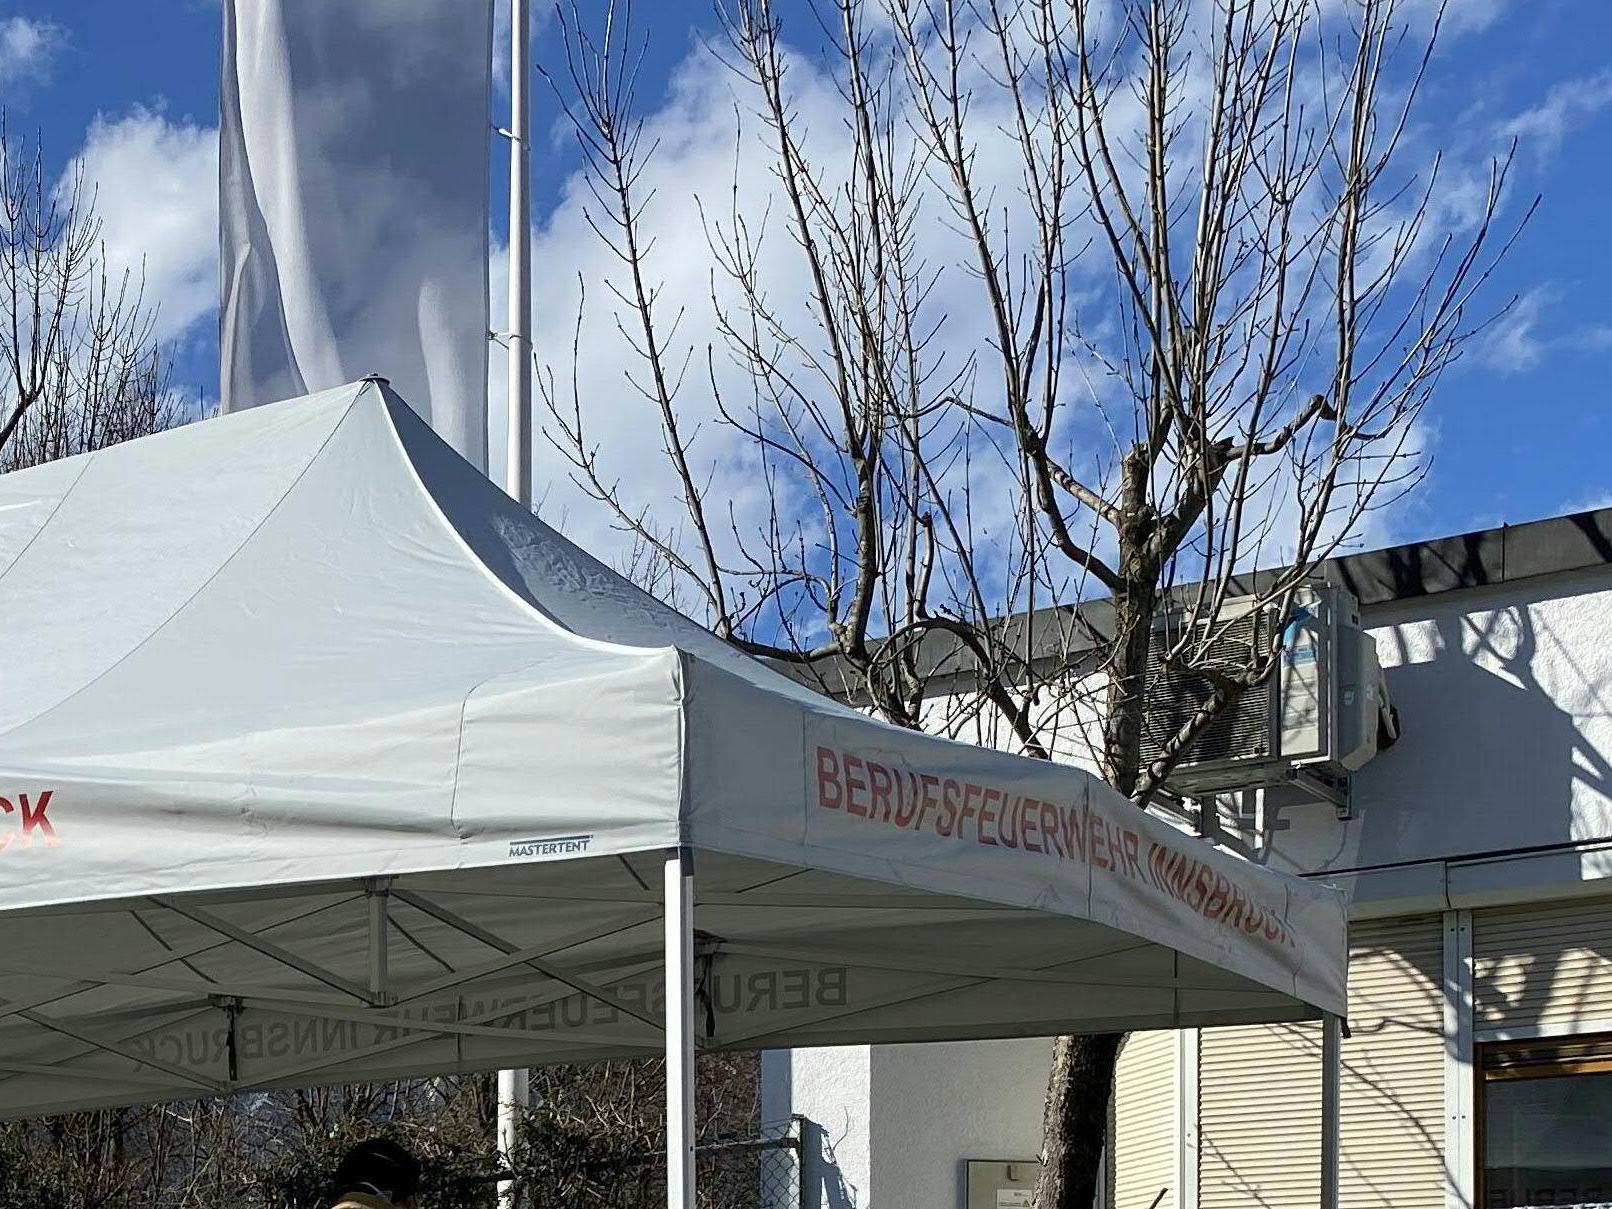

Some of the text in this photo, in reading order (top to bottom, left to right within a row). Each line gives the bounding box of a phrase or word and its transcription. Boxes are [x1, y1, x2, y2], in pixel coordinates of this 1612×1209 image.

[508, 839, 590, 857] MASTERTENT
[815, 746, 1297, 948] BERUFSFEUERWEHR INNSBRUCK
